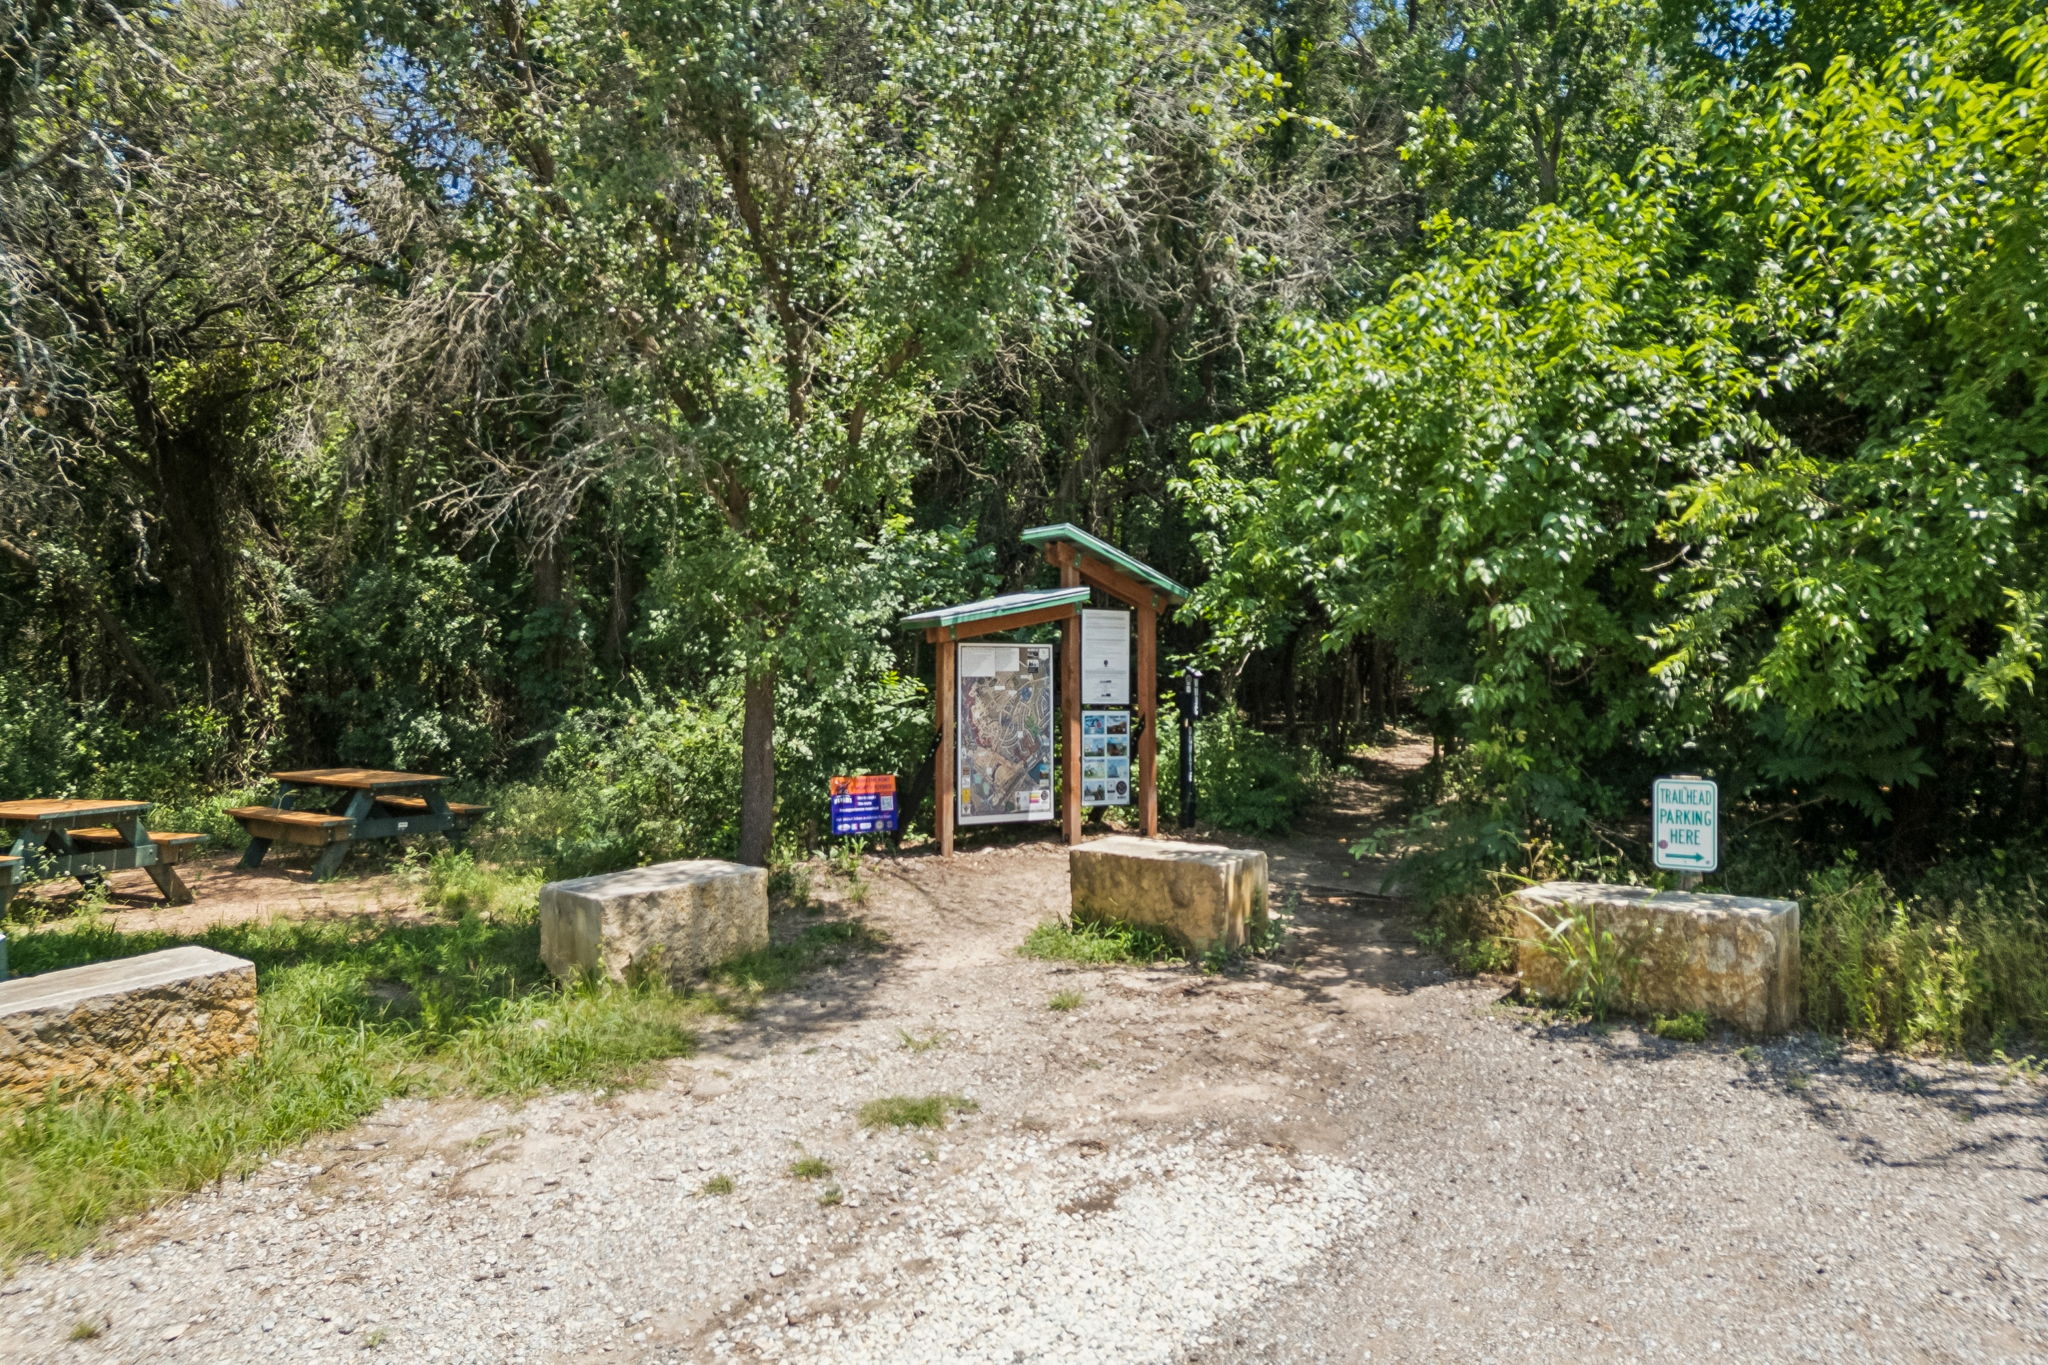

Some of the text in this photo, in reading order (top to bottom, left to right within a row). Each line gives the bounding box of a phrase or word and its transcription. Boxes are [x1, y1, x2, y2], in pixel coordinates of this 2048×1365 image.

[1660, 788, 1712, 806] TRAILHEAD
[1660, 808, 1712, 826] PARKING
[1670, 829, 1701, 845] HERE
